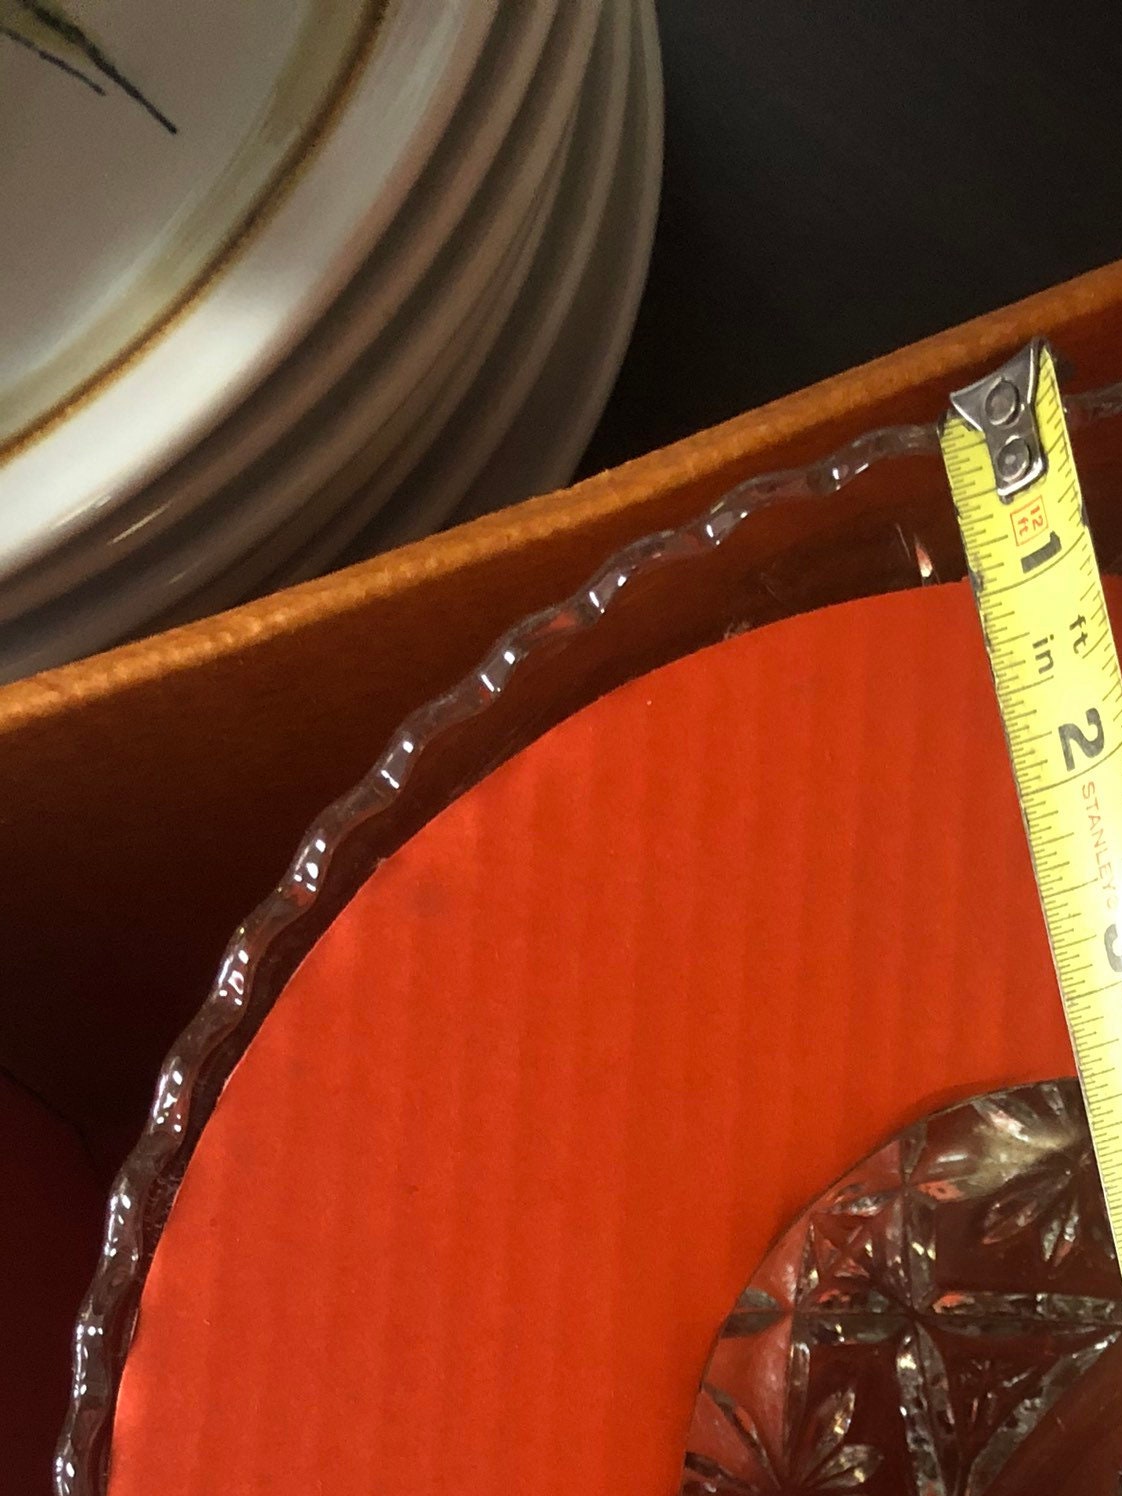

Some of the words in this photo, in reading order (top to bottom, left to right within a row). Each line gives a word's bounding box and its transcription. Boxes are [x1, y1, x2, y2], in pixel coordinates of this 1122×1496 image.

[1017, 516, 1029, 537] ft
[1030, 505, 1044, 531] 12
[1020, 530, 1062, 574] 1
[1033, 633, 1055, 674] in
[1069, 613, 1088, 655] ft
[1058, 707, 1105, 772] 2
[1082, 781, 1116, 890] STANLEY
